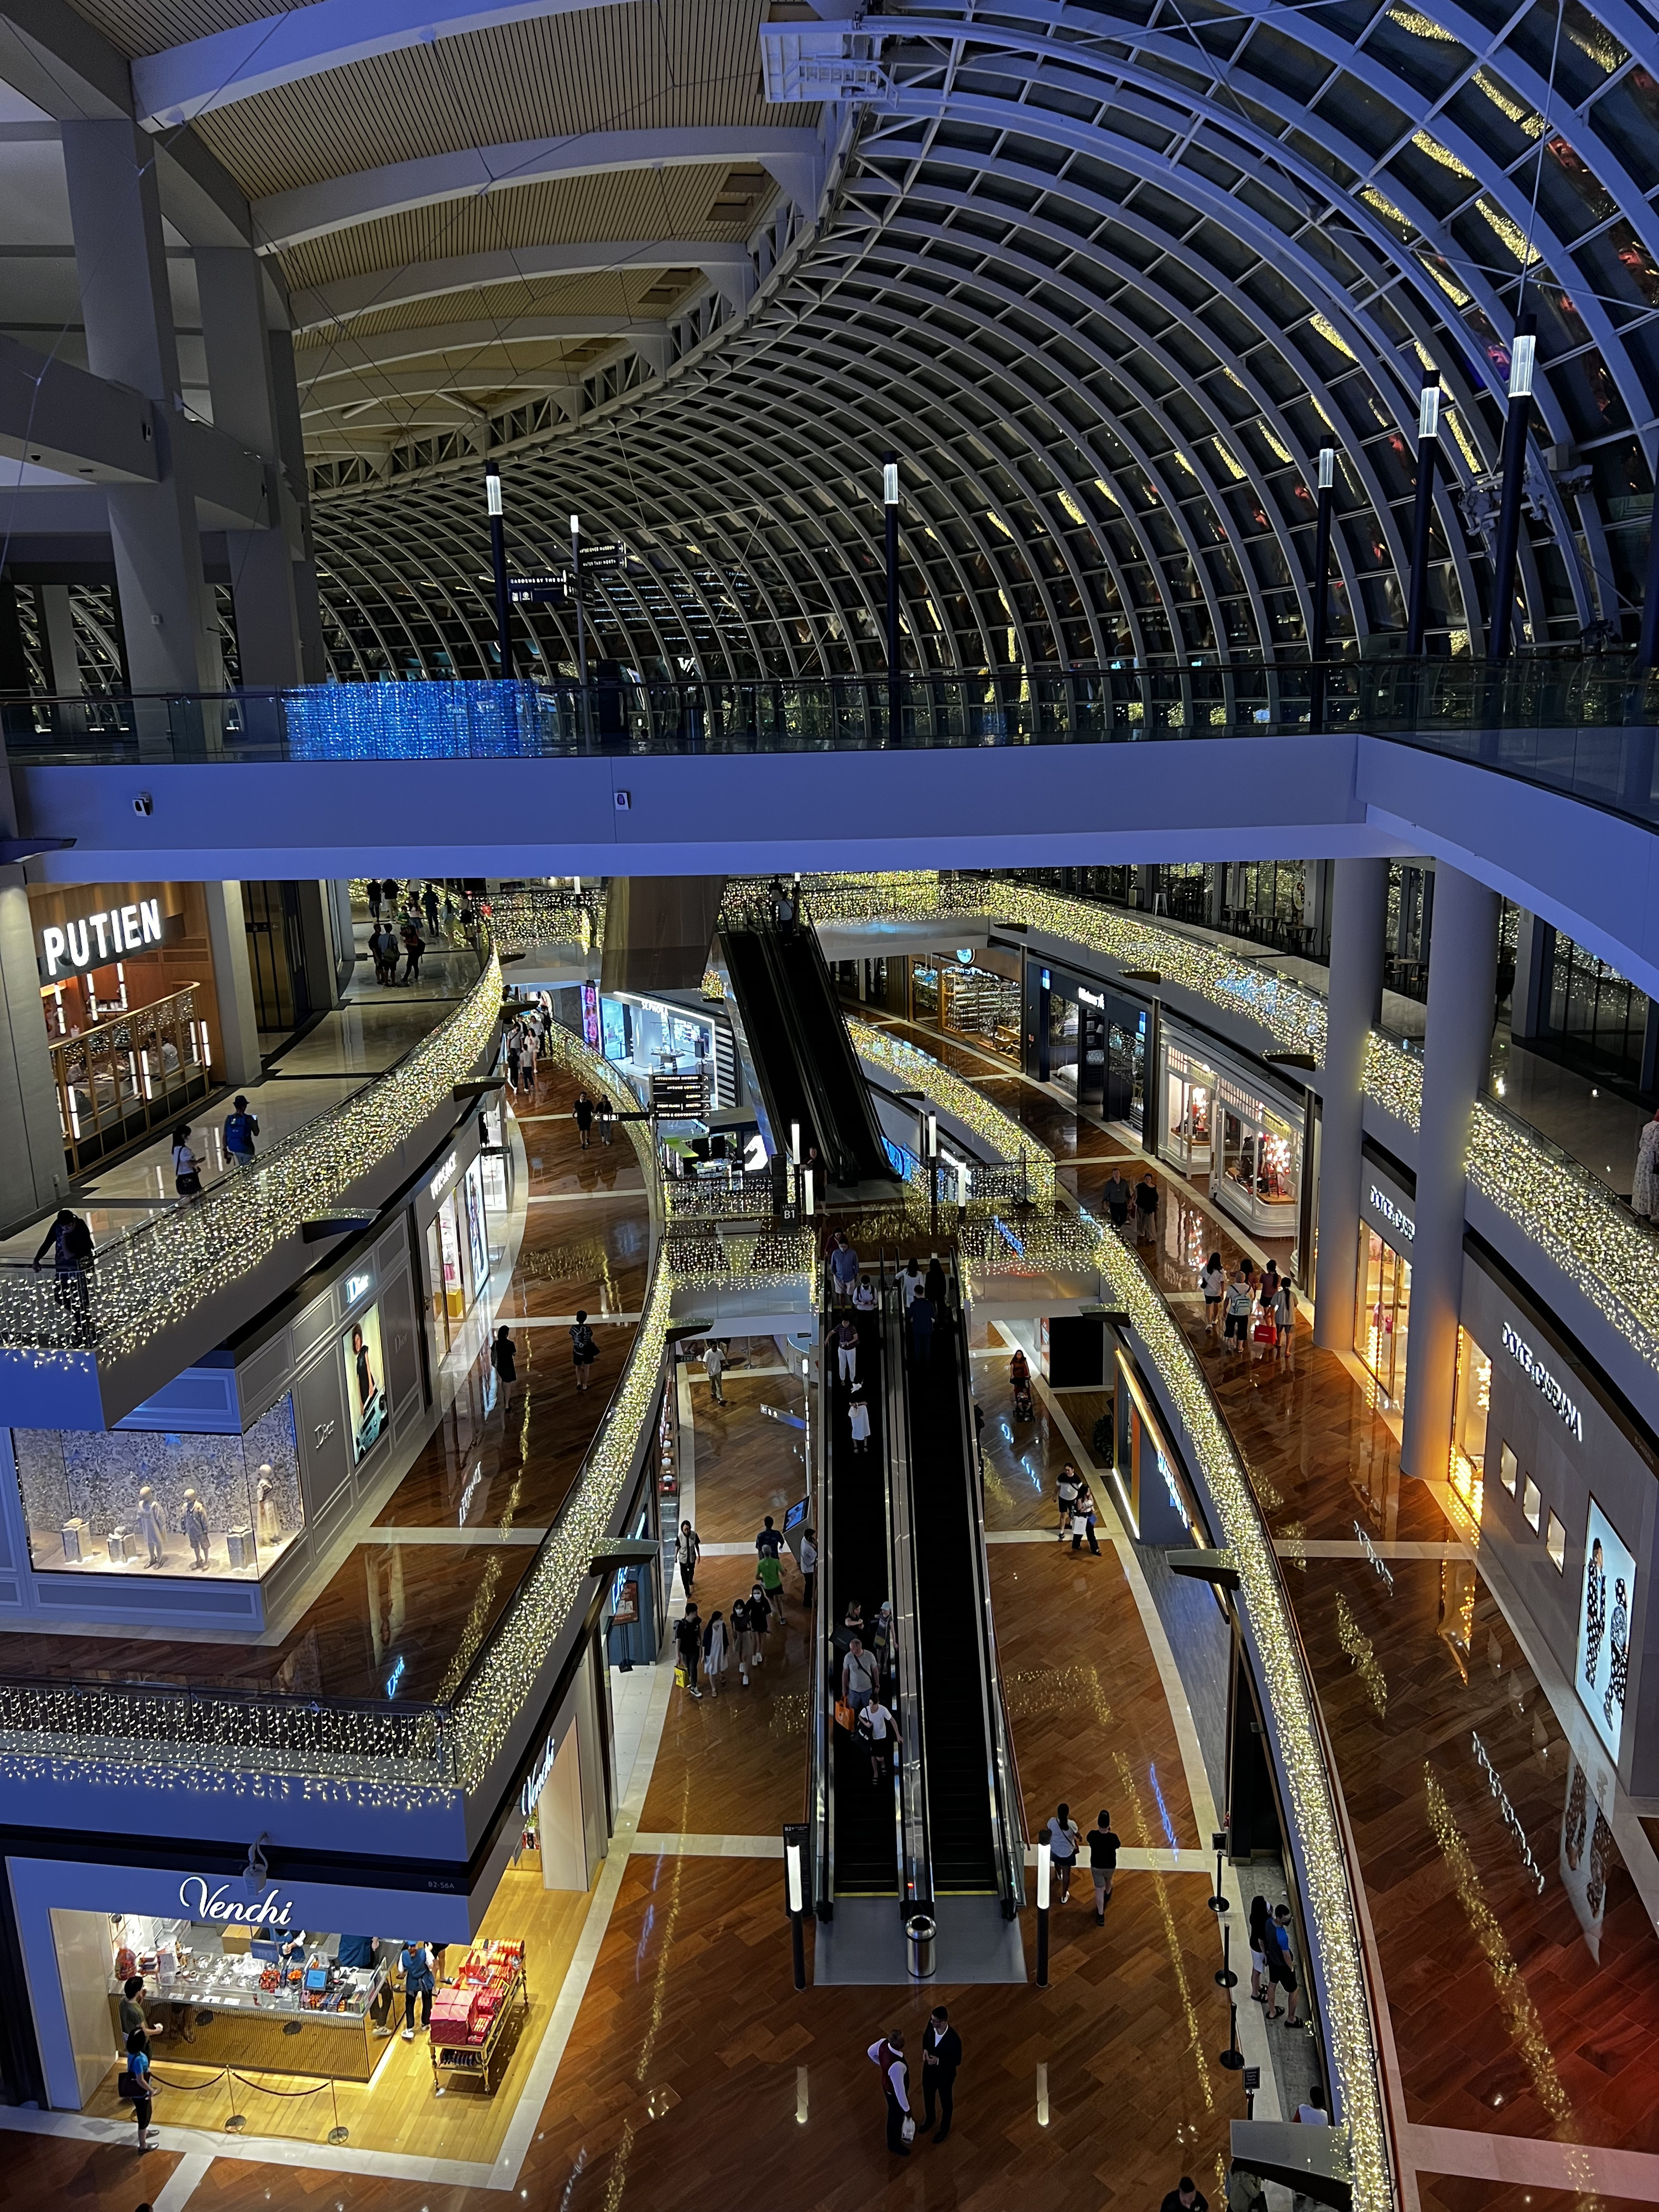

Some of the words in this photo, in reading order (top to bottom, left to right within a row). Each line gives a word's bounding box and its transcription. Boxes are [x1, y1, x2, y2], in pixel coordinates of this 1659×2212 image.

[43, 898, 161, 976] PUTIEN
[784, 1209, 795, 1219] B1
[346, 1274, 369, 1303] Dior
[394, 1332, 408, 1355] Dior
[315, 1419, 335, 1449] Dior
[179, 1876, 293, 1925] Venchi
